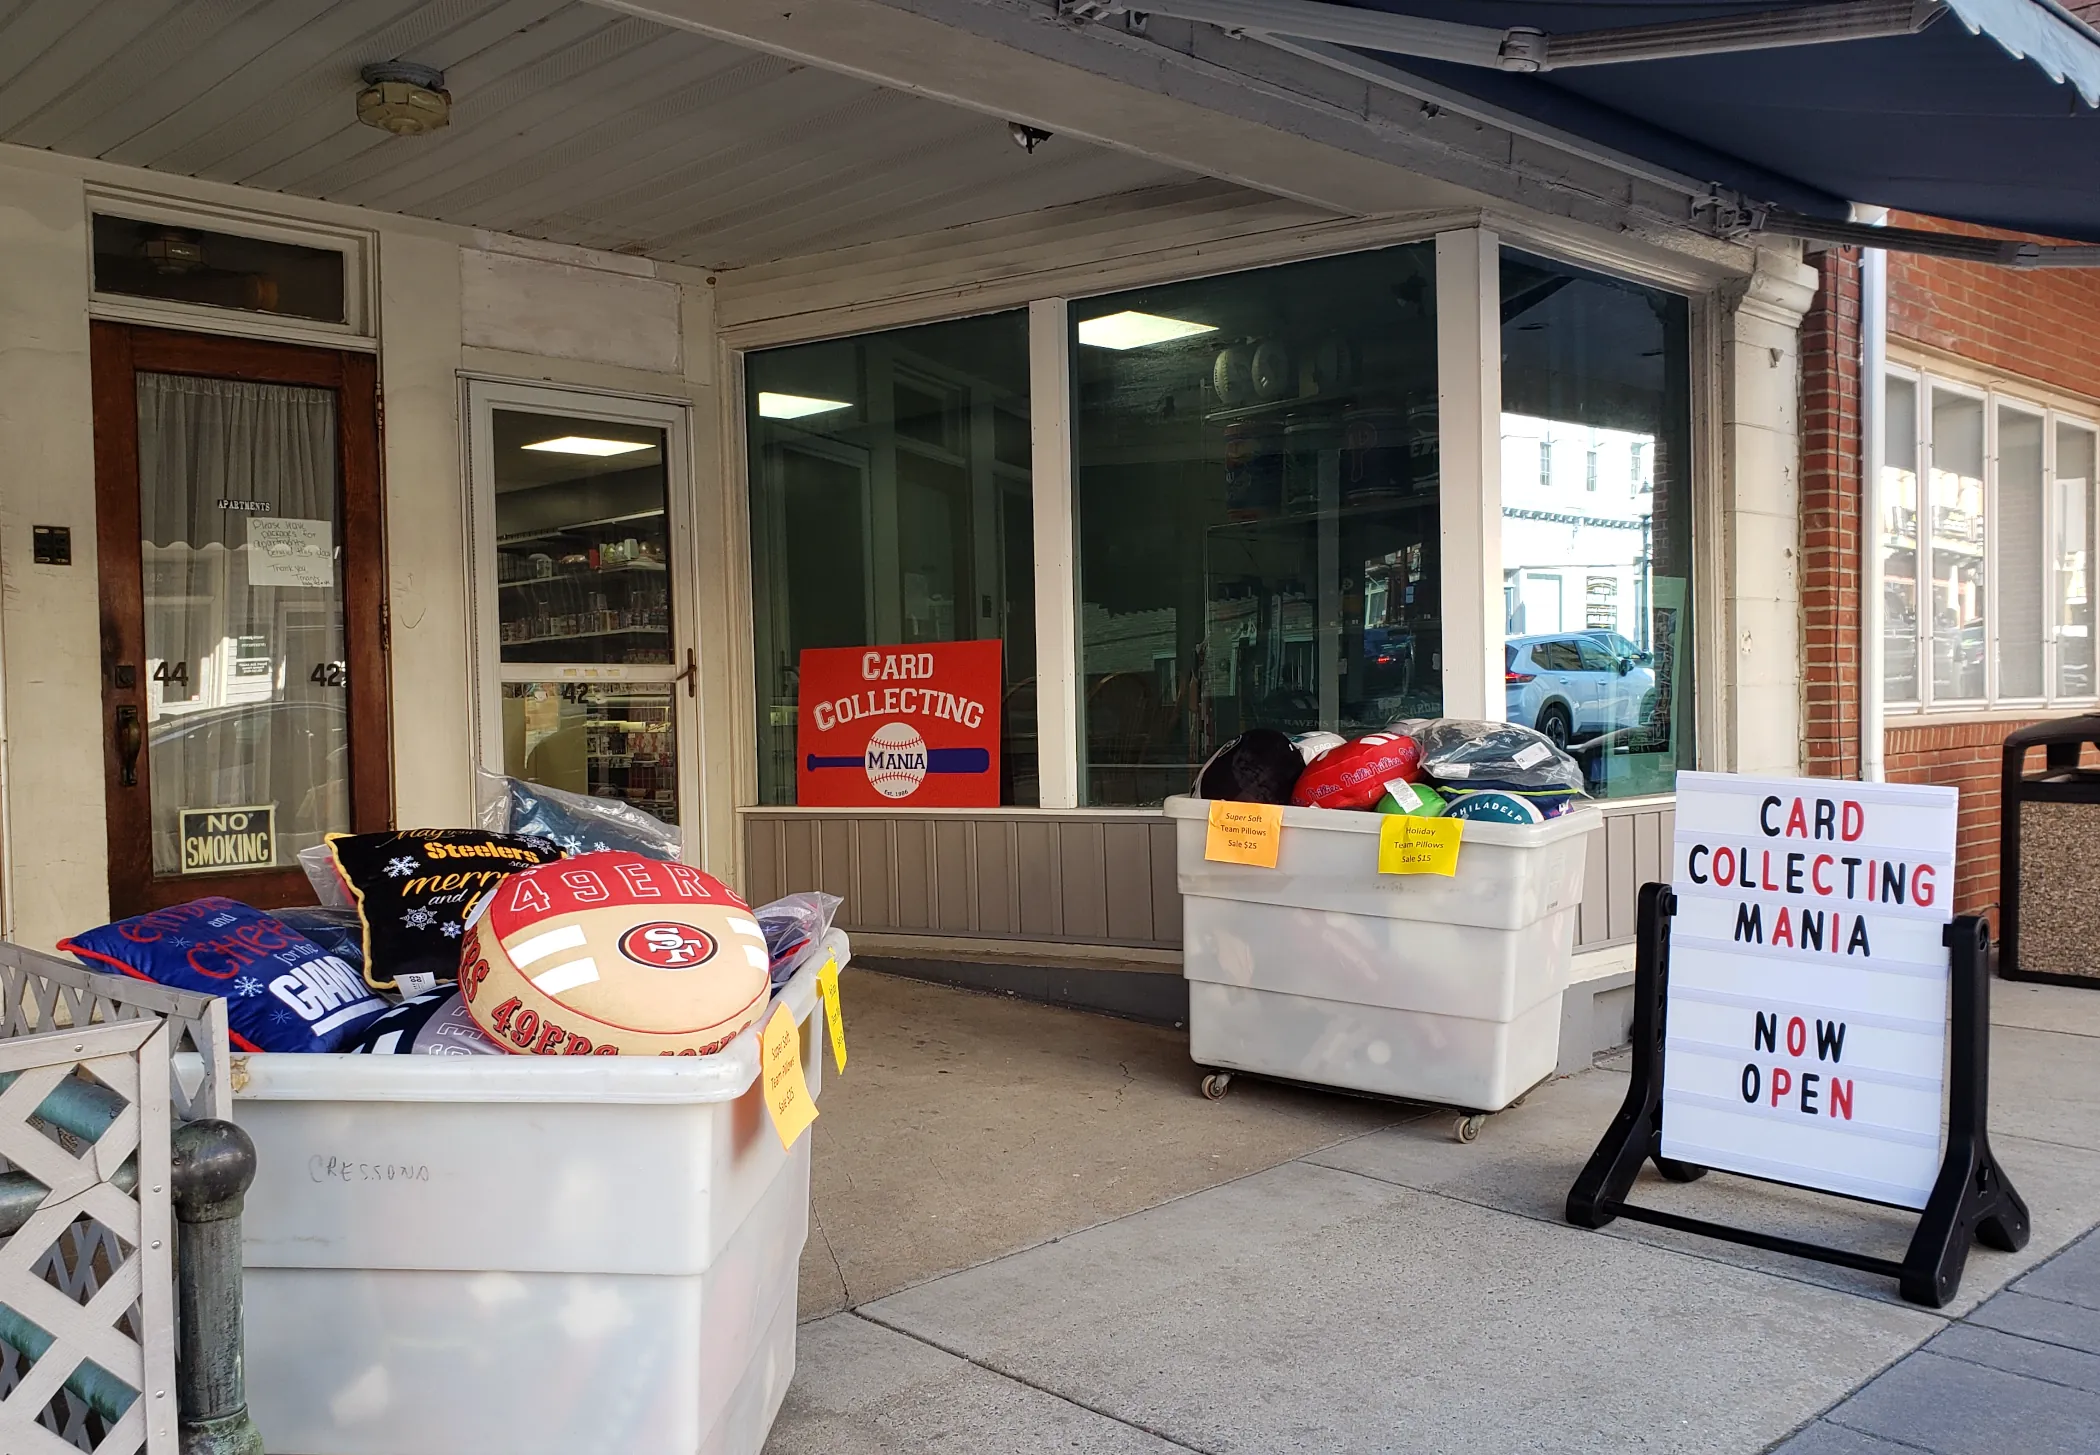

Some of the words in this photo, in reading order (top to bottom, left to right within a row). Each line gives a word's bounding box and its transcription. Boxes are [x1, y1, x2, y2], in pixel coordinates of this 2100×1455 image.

[218, 500, 271, 511] APARTMENTS
[253, 519, 281, 530] Please
[303, 530, 316, 538] for
[267, 564, 293, 573] Thank
[154, 662, 189, 687] 44
[310, 663, 341, 687] 42
[862, 652, 934, 680] CARD
[563, 682, 590, 704] 42
[813, 687, 985, 732] COLLECTING
[868, 751, 926, 770] MANIA
[207, 813, 249, 833] NO
[1226, 812, 1246, 822] Super
[1247, 814, 1262, 823] Soft
[1451, 802, 1526, 825] PHILADELP
[1760, 795, 1865, 842] CARD
[1220, 824, 1240, 834] Team
[1241, 827, 1267, 836] Pillows
[1405, 827, 1436, 837] Holiday
[186, 831, 269, 867] SMOKING
[424, 841, 540, 864] Steelers
[1228, 840, 1243, 848] Sale
[1244, 841, 1257, 850] $25
[1394, 841, 1414, 849] Team
[1416, 841, 1444, 849] Pillows
[1402, 855, 1416, 863] Sale
[1417, 854, 1432, 863] $15
[1689, 844, 1937, 907] COLLECTING
[428, 890, 465, 906] and
[209, 912, 238, 929] and
[1734, 901, 1871, 958] MANIA
[273, 950, 299, 967] for
[296, 942, 319, 957] the
[644, 926, 703, 963] SF
[772, 1041, 783, 1061] Super
[782, 1030, 791, 1049] Soft
[1755, 1010, 1847, 1064] NOW
[771, 1071, 782, 1091] Team
[782, 1056, 795, 1076] Pillows
[779, 1098, 788, 1115] Sale
[786, 1086, 795, 1105] $25
[1741, 1063, 1854, 1121] OPEN
